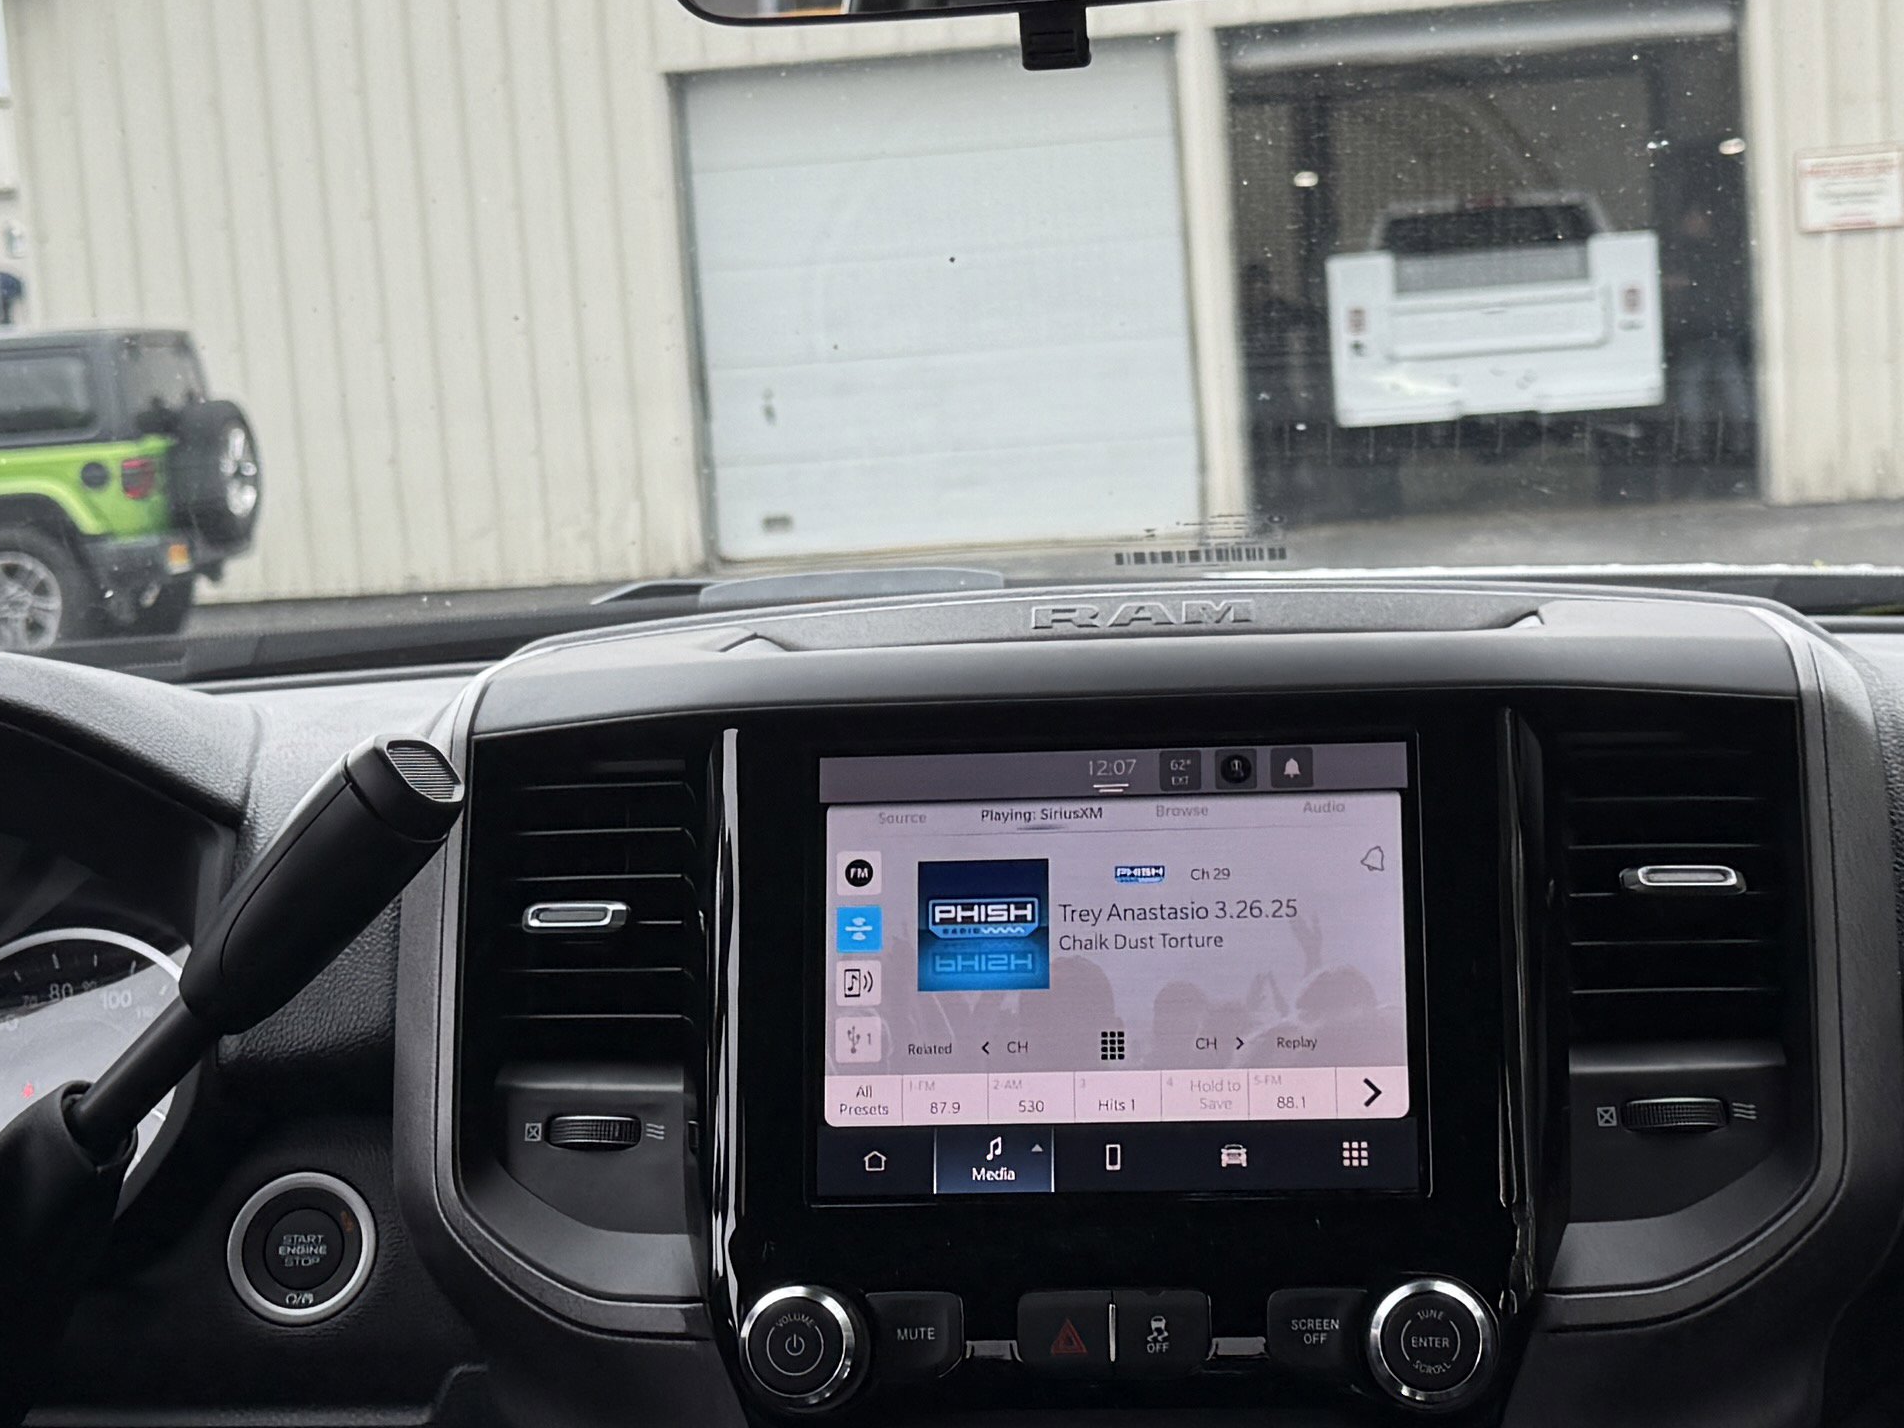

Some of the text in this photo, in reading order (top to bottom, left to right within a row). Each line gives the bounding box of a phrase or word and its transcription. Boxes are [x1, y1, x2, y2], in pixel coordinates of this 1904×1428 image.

[1029, 597, 1258, 631] RAM
[1088, 758, 1137, 777] 12:07
[1155, 803, 1209, 818] Browse
[1302, 800, 1346, 815] Audio
[877, 811, 927, 825] Source
[980, 806, 1103, 824] Playing: SiriusXM
[850, 867, 869, 879] FM
[1190, 867, 1231, 881] Ch 29
[933, 903, 1033, 923] PHISH
[1058, 898, 1298, 927] Trey Anastasio 3.26.25
[1058, 932, 1224, 951] Chalk Dust Torture
[48, 981, 74, 1001] 80
[101, 988, 133, 1010] 100
[907, 1043, 953, 1056] Related
[1006, 1041, 1029, 1055] CH
[1195, 1037, 1218, 1051] CH
[1276, 1036, 1318, 1051] Replay
[855, 1084, 873, 1099] All
[1189, 1078, 1242, 1093] Hold to
[839, 1102, 890, 1116] Presets
[929, 1100, 961, 1115] 87.9
[1017, 1099, 1045, 1114] 530
[1098, 1098, 1127, 1112] Hits
[1198, 1097, 1233, 1111] Save
[1276, 1095, 1307, 1110] 88.1
[971, 1167, 1016, 1181] Media
[282, 1233, 325, 1244] START
[278, 1244, 328, 1256] ENGINE
[284, 1257, 321, 1267] STOP
[775, 1312, 817, 1329] VOLUME
[1416, 1309, 1445, 1321] TUNE
[1291, 1318, 1340, 1331] SCREEN
[896, 1327, 936, 1341] MUTE
[1303, 1332, 1328, 1345] OFF
[1146, 1342, 1169, 1354] OFF
[1411, 1335, 1450, 1349] ENTER
[1412, 1359, 1452, 1374] SCROLL
